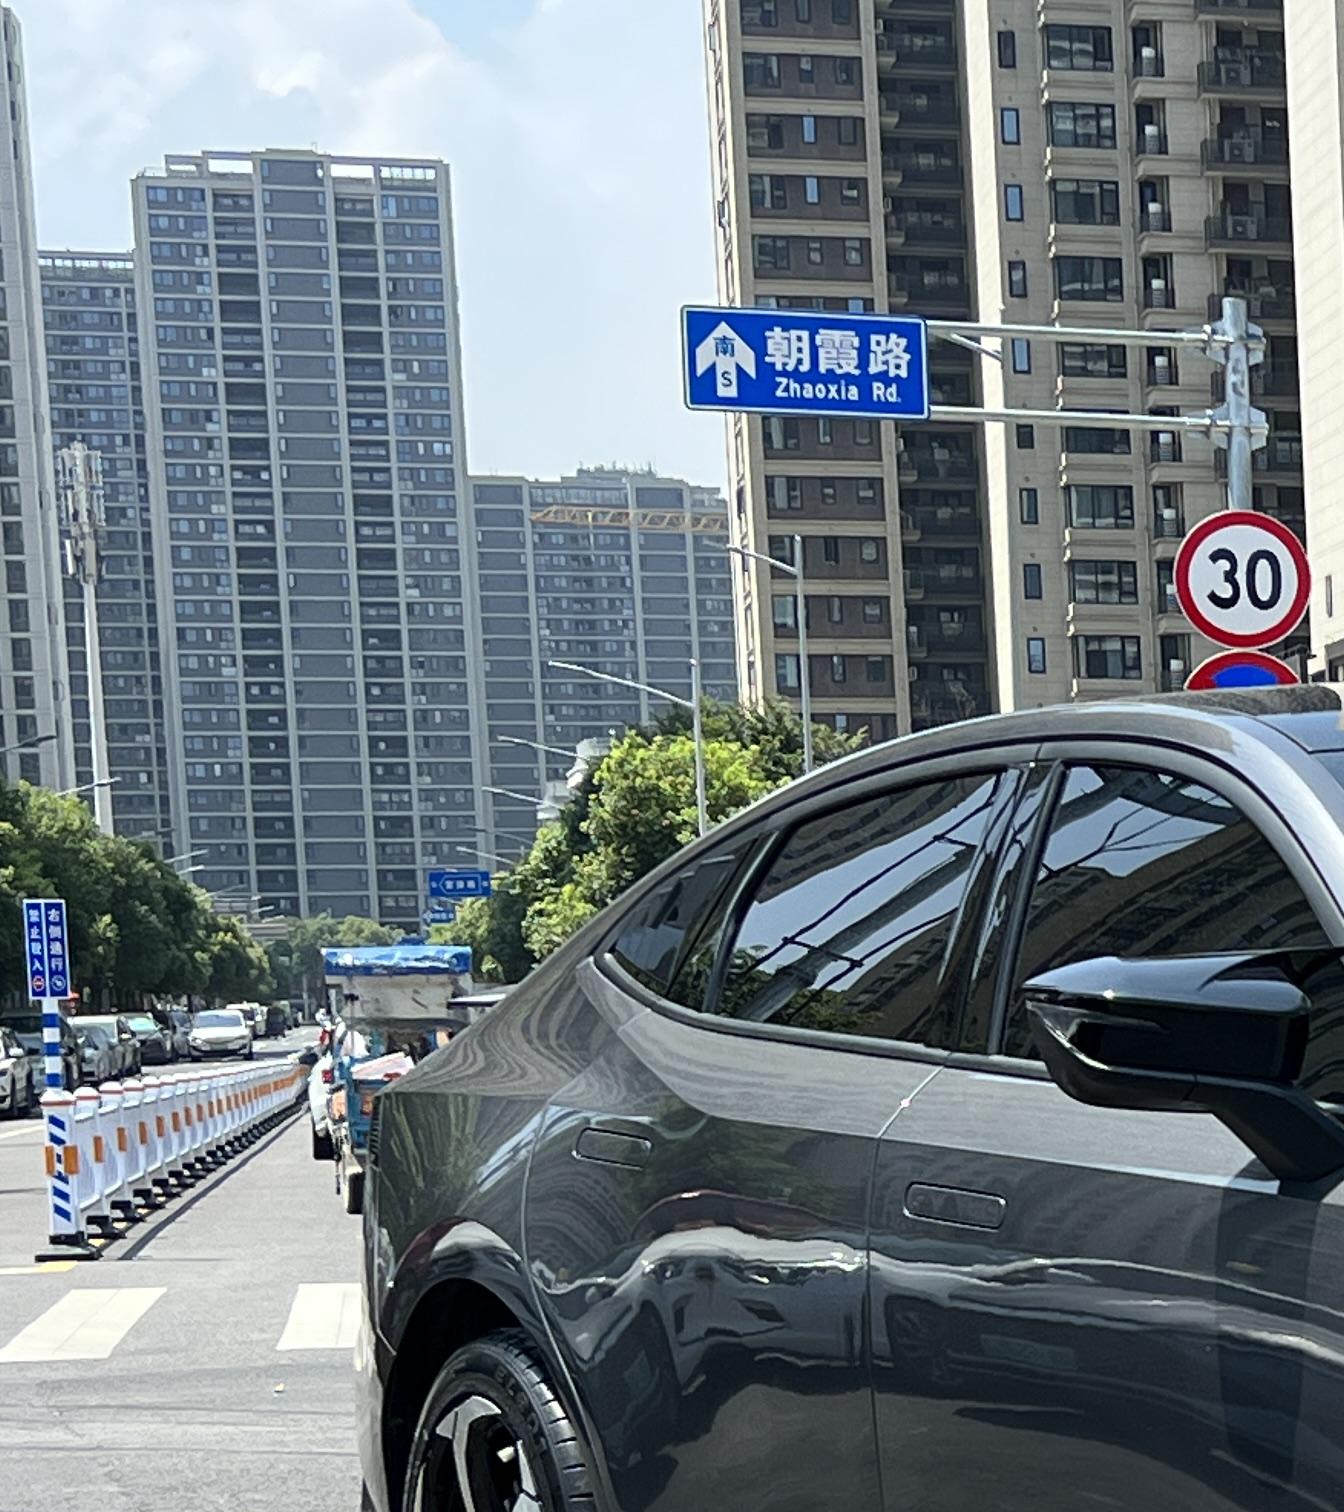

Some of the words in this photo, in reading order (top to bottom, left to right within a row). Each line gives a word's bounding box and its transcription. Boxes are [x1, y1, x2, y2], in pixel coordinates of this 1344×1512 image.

[713, 335, 735, 358] 南
[764, 326, 912, 379] 朝霞路
[721, 370, 732, 388] S
[775, 377, 859, 401] Zhaoxia
[872, 382, 902, 403] Rd.
[1207, 547, 1283, 611] 30
